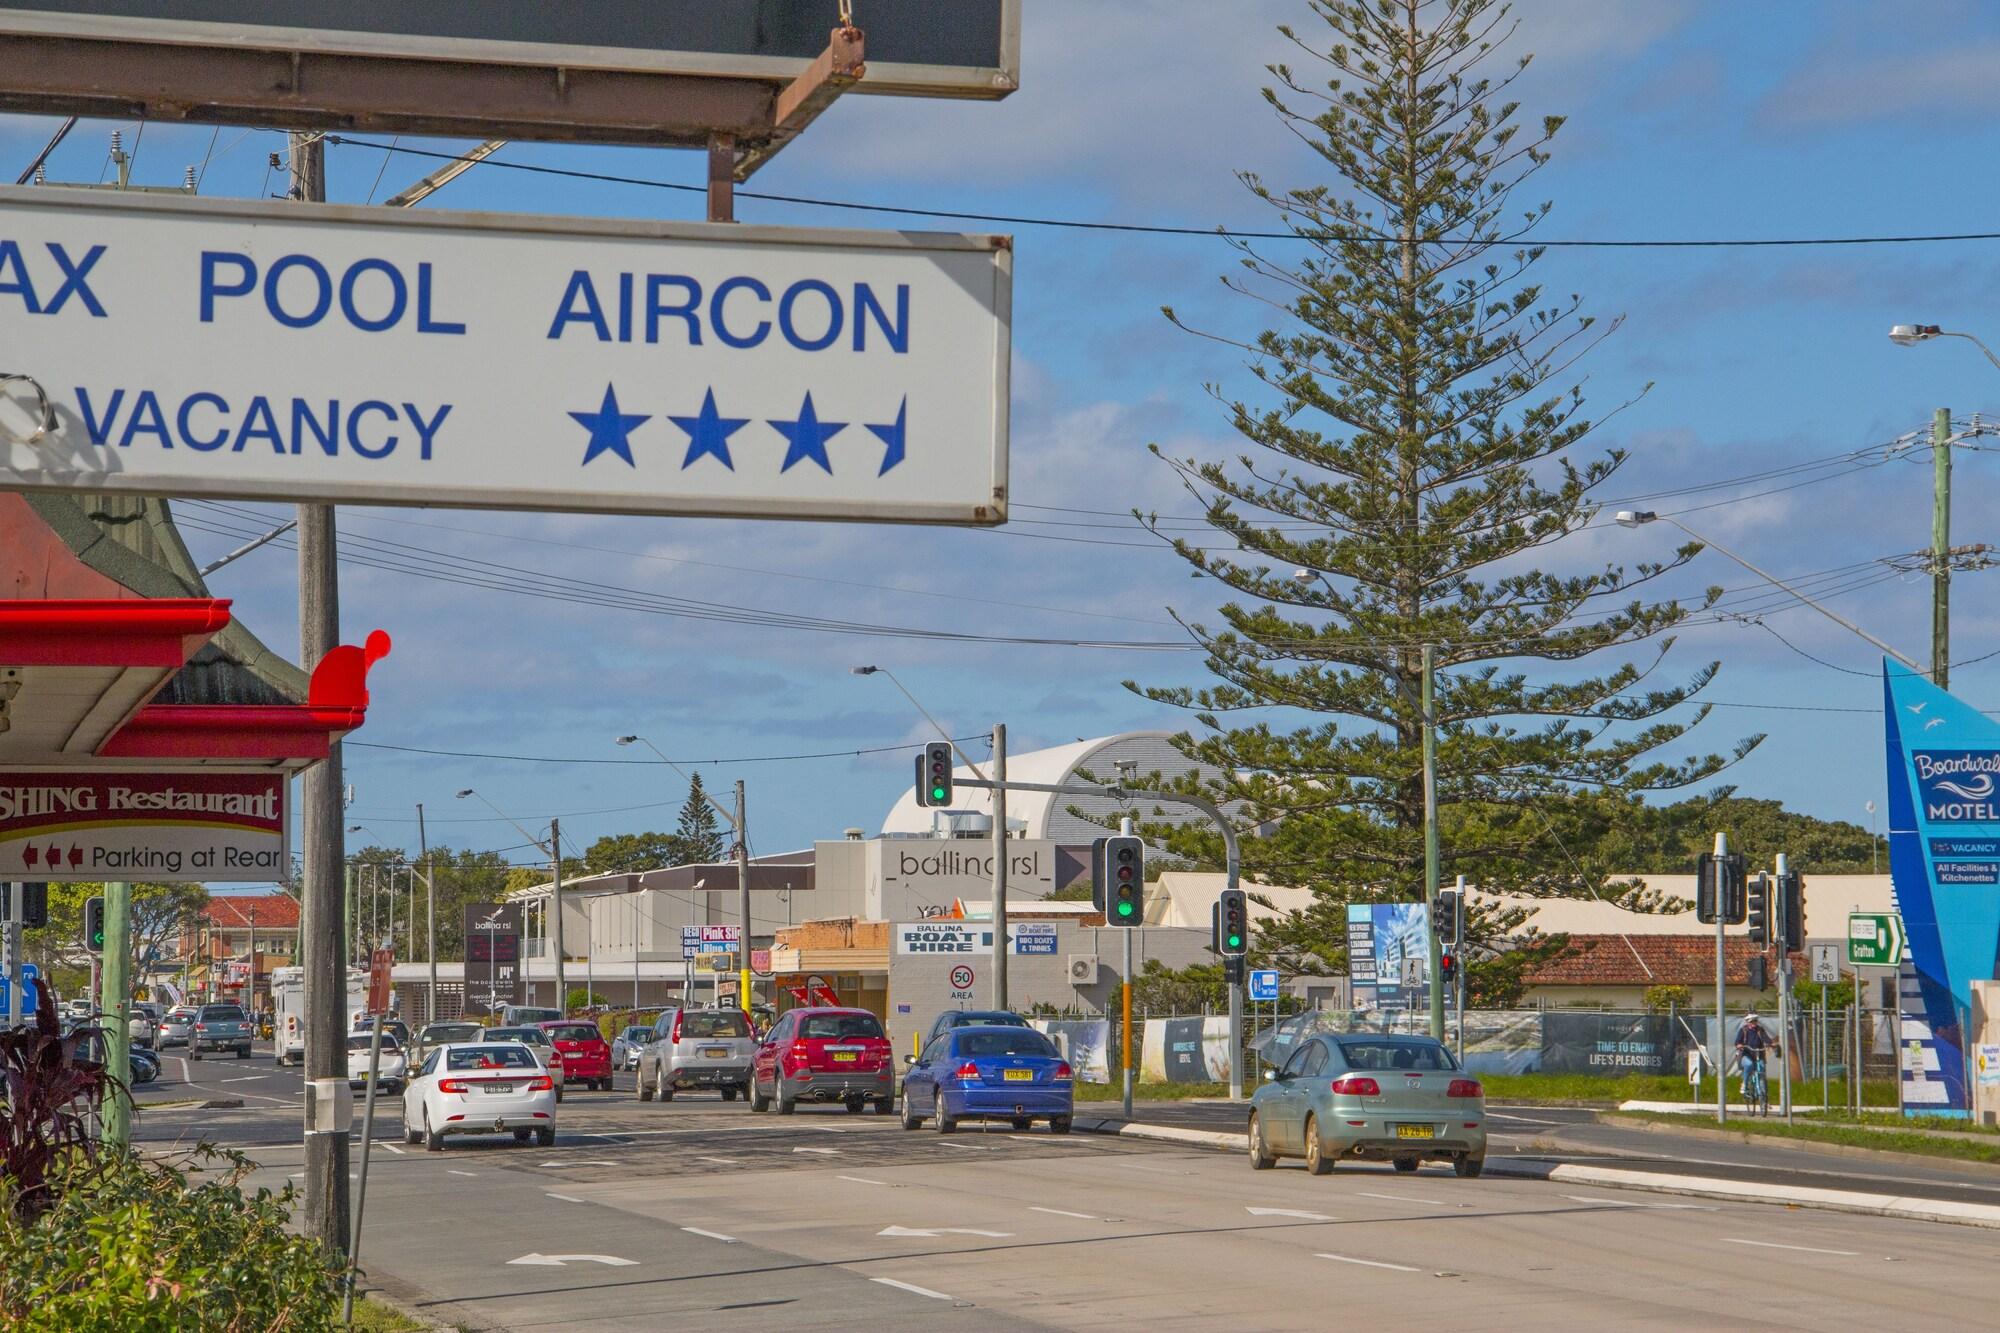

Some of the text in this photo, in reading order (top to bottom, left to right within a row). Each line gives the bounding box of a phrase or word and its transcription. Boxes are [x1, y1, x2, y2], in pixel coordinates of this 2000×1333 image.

[199, 250, 467, 336] POOL
[546, 269, 910, 354] AIRCON
[74, 387, 453, 461] VACANCY
[107, 786, 279, 821] Restaurant
[1929, 803, 2000, 820] MOTEL
[1951, 844, 1997, 852] VACANCY
[93, 846, 280, 873] Parking at Rear
[1012, 851, 1038, 876] rsl
[1937, 863, 1998, 872] All Facilities &
[1941, 873, 1995, 882] Kitchenettes
[703, 927, 724, 940] Pink
[904, 932, 978, 942] BOAT
[909, 942, 974, 952] HIRE
[1034, 937, 1054, 945] BOATS
[1853, 944, 1875, 958] Grafton
[954, 972, 970, 983] 50
[1816, 973, 1834, 981] END
[950, 992, 974, 1000] AREA
[1596, 1041, 1655, 1053] TIME TO ENJOY
[1589, 1054, 1663, 1067] LIFE'S PLEASURES
